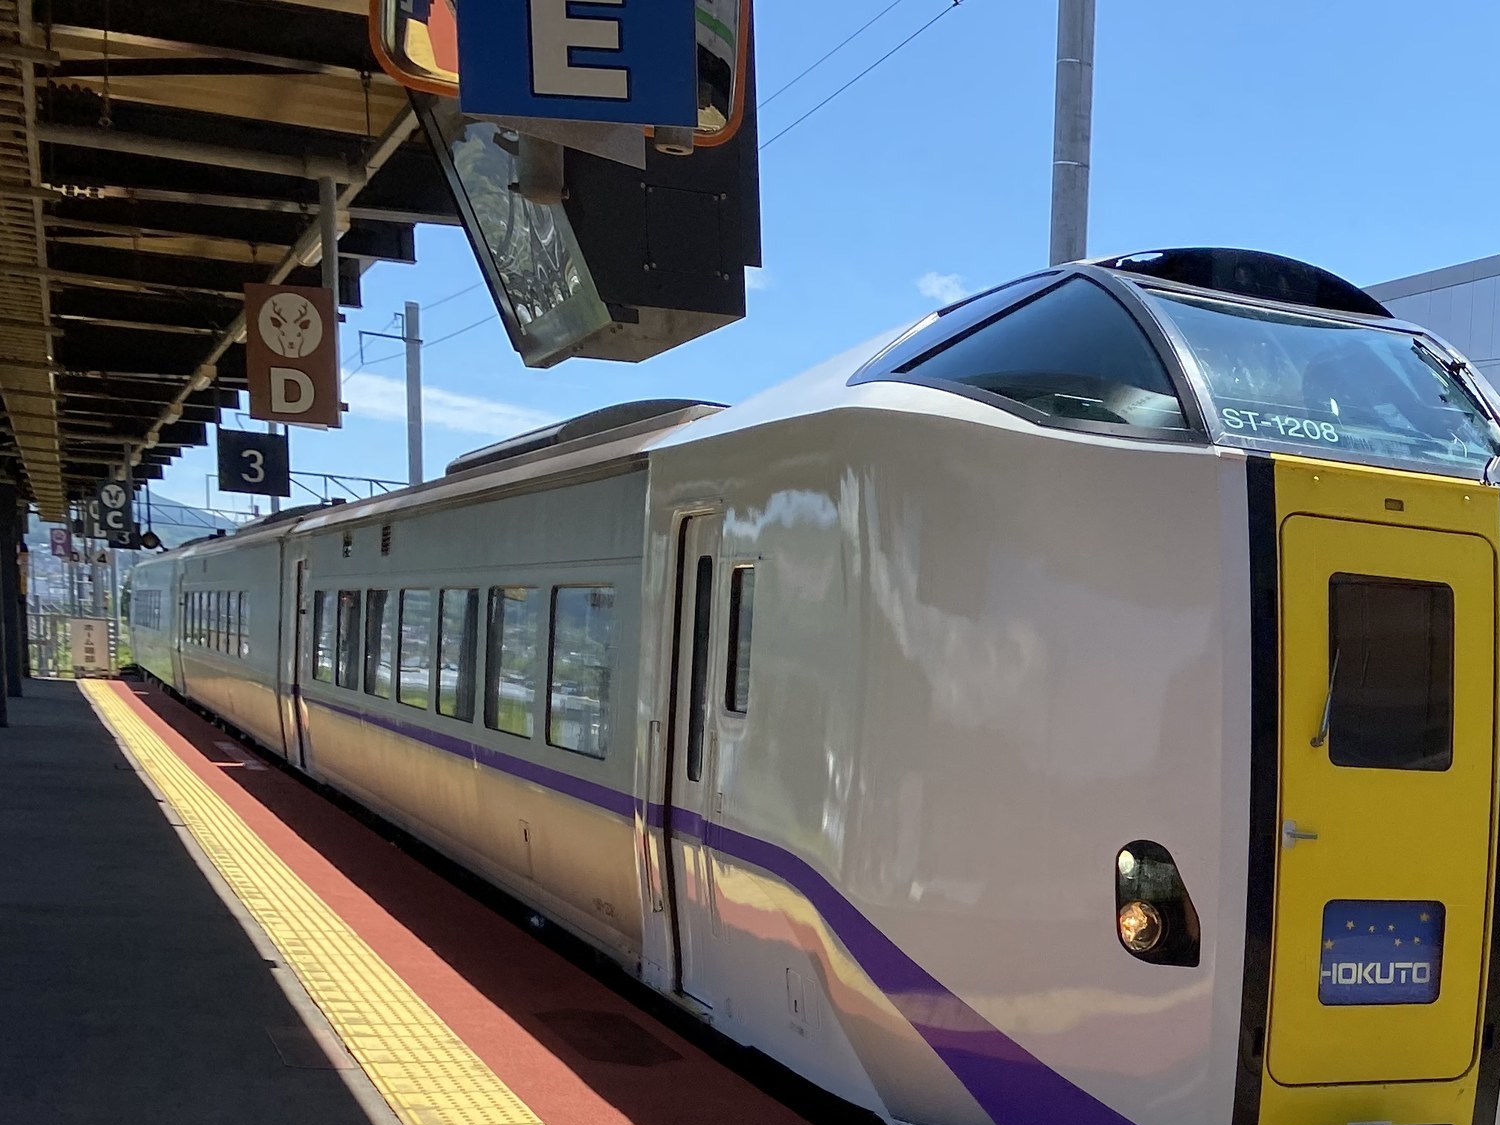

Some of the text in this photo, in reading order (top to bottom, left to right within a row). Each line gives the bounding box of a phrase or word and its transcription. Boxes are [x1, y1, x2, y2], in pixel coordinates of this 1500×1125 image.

[530, 0, 628, 99] E
[270, 367, 315, 414] D
[1222, 408, 1339, 443] ST-1208
[240, 449, 265, 483] 3
[106, 510, 123, 529] C
[55, 544, 65, 555] A
[1320, 962, 1431, 985] HOKUTO
